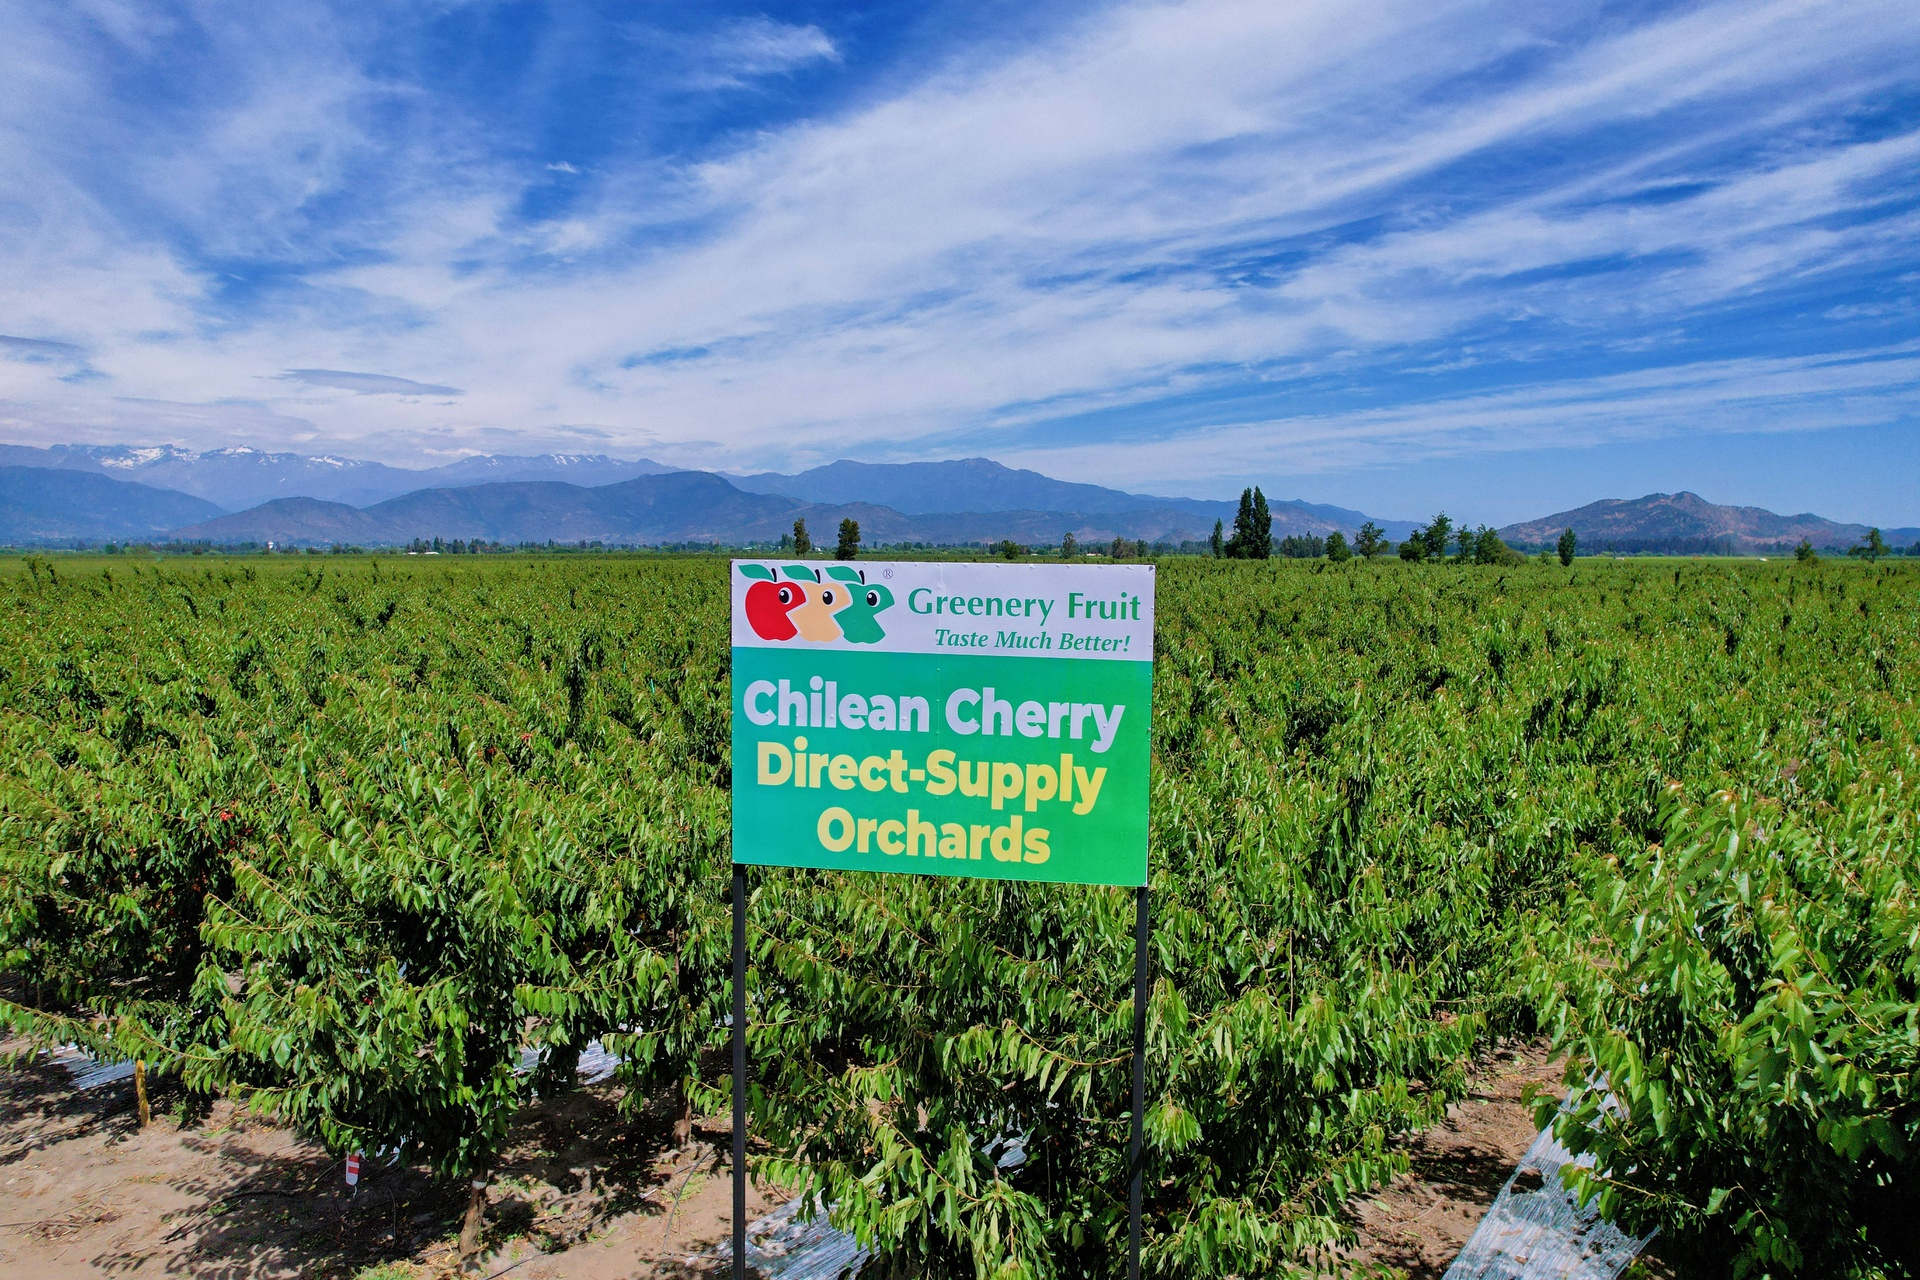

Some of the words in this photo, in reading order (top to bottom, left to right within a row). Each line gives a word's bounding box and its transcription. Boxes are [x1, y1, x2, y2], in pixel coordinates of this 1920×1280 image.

[908, 587, 1055, 626] Greenery
[1068, 591, 1141, 621] Fruit
[934, 628, 988, 648] Taste
[994, 630, 1054, 650] Much
[1058, 632, 1131, 653] Better!
[743, 675, 930, 732] Chilean
[945, 687, 1126, 753] Cherry
[757, 736, 1107, 815] Direct-Supply
[816, 806, 1051, 865] Orchards
